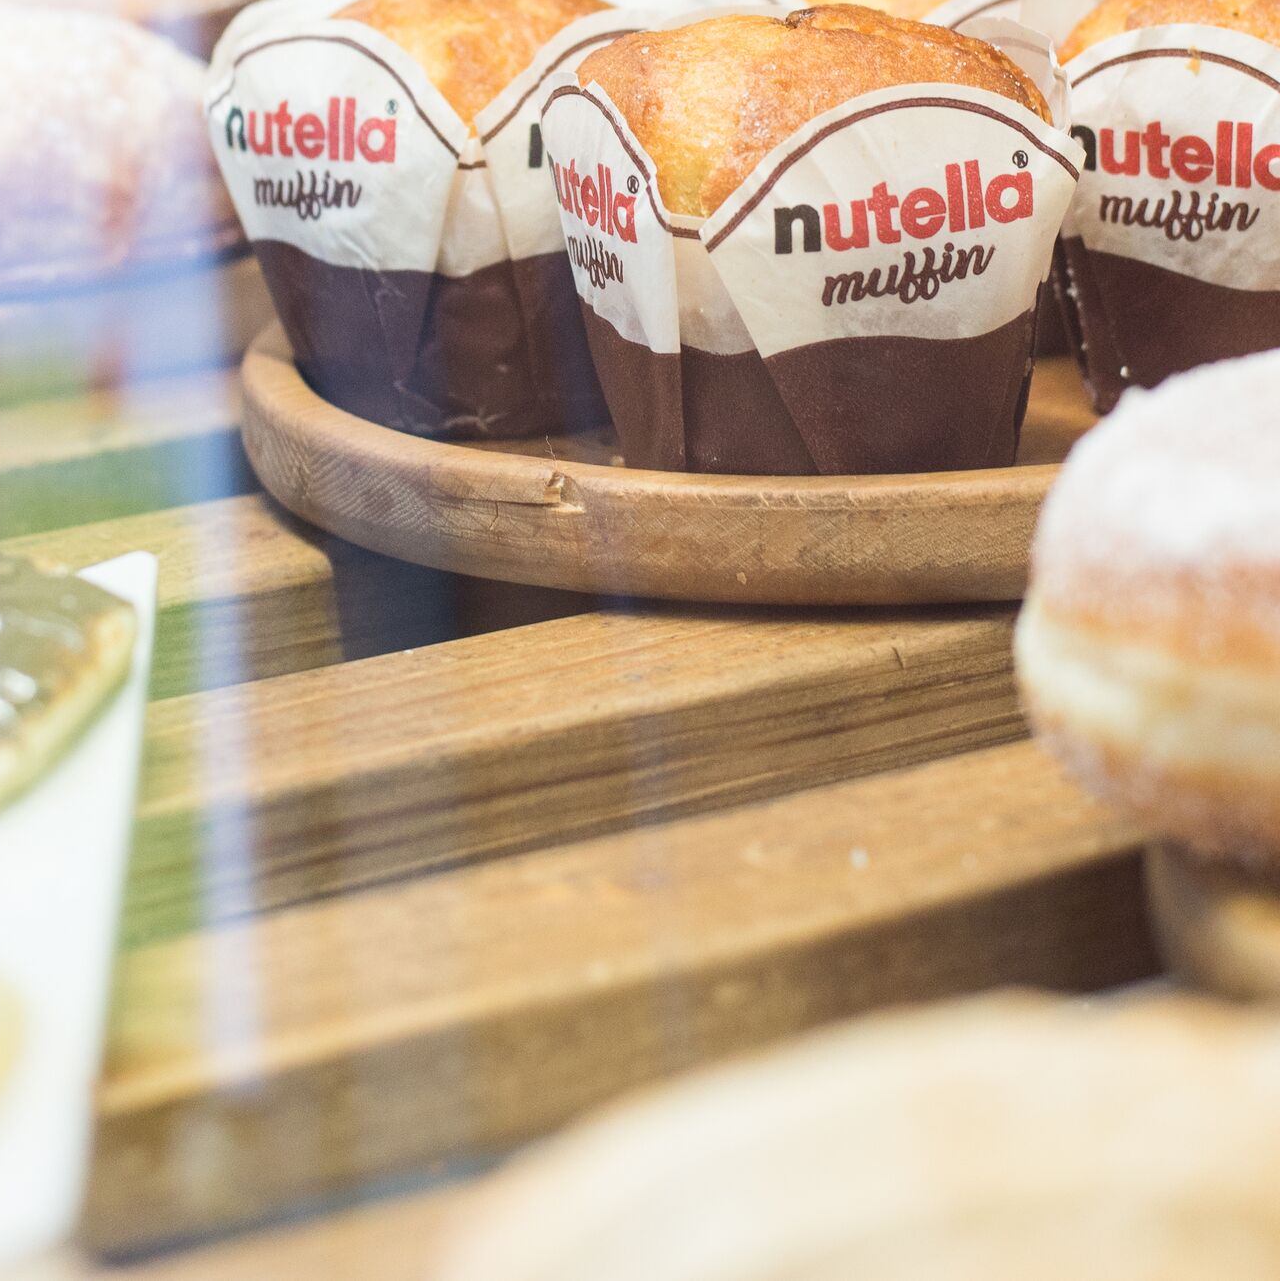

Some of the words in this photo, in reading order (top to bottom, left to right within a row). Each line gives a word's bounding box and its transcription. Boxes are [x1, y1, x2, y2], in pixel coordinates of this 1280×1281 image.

[225, 97, 397, 163] nutella
[254, 170, 362, 221] muffin
[547, 151, 638, 244] utella
[774, 159, 1034, 254] nutella
[1099, 190, 1260, 242] muffin
[567, 235, 624, 289] muffin
[821, 242, 996, 306] muffin
